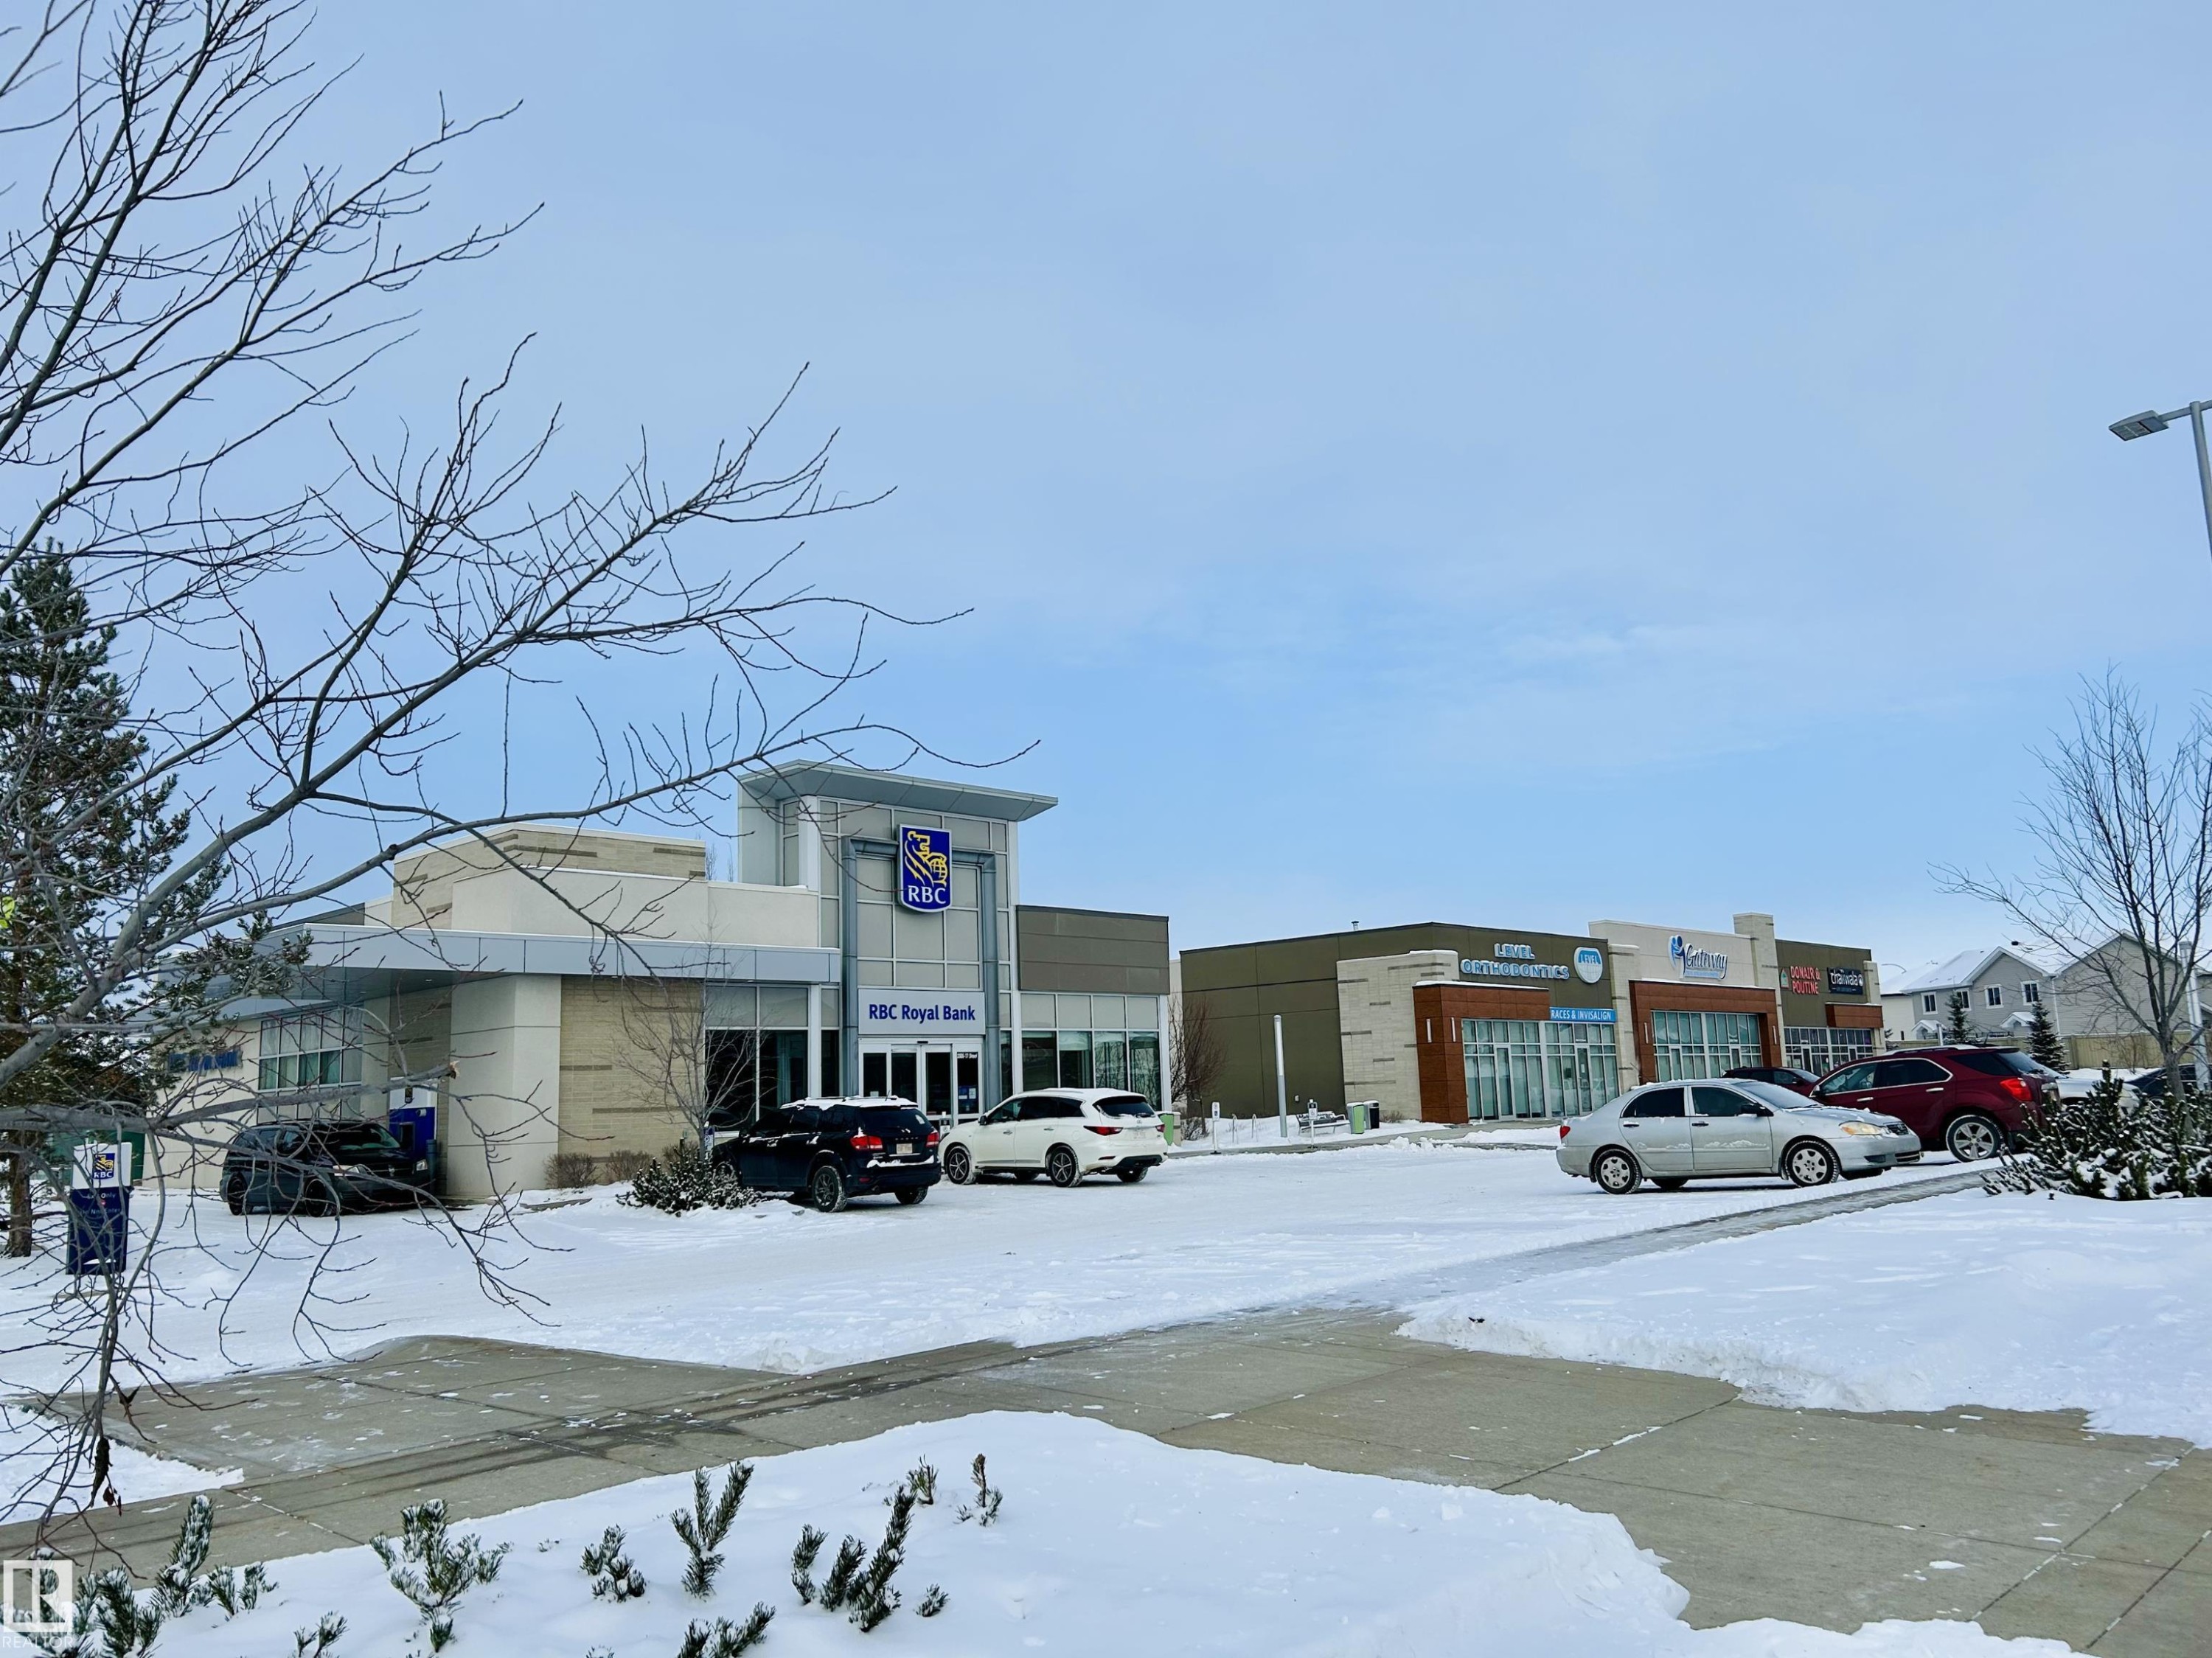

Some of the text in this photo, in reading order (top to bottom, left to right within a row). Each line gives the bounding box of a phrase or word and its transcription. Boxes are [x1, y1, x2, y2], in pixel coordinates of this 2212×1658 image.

[908, 885, 946, 904] RBC
[1495, 943, 1535, 959] LEVEL
[1580, 953, 1601, 964] LEVEL
[1461, 959, 1570, 980] ORTHODONTICS
[1686, 944, 1728, 980] Gateway
[1790, 966, 1821, 980] DONAIR &
[1792, 981, 1819, 995] POUTINE
[869, 1004, 975, 1023] RBC Royal Bank
[1571, 1010, 1576, 1019] &
[1578, 1011, 1612, 1020] INVISALIGN
